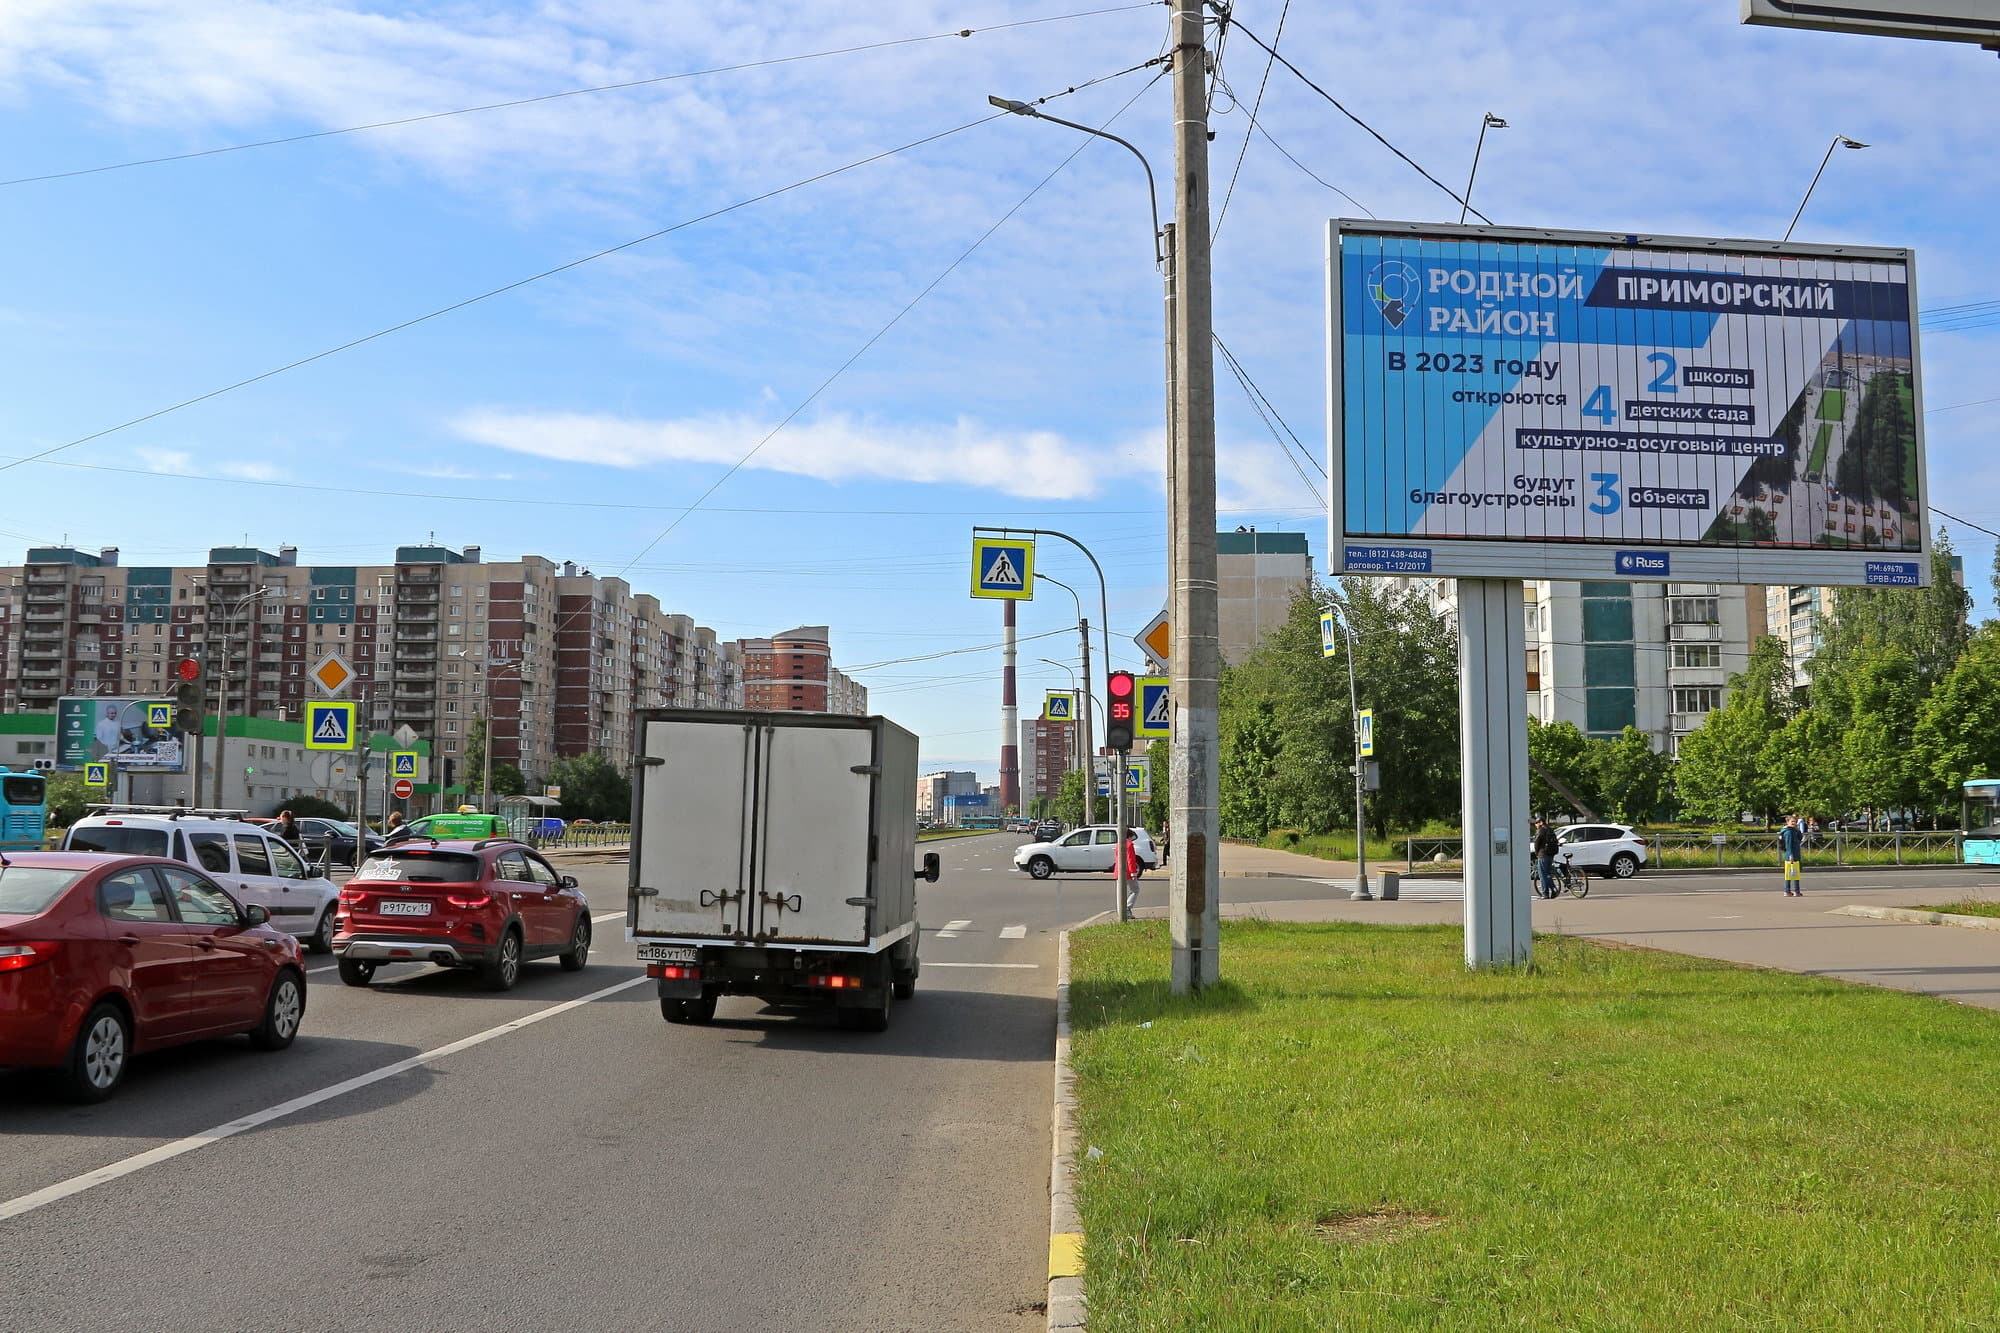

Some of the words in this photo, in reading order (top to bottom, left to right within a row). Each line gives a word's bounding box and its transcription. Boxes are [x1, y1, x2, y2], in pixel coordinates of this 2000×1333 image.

[1428, 268, 1584, 302] РОДНОЙ
[1617, 276, 1835, 311] ПРИМОРСКИЙ
[1429, 303, 1556, 337] РАЙОН
[1388, 351, 1407, 371] В
[1415, 352, 1484, 374] 2023
[1494, 359, 1560, 381] году
[1646, 351, 1679, 394] 2
[1688, 370, 1749, 385] школы
[1452, 390, 1567, 407] откроются
[1581, 385, 1617, 426] 4
[1629, 404, 1702, 420] детских
[1707, 408, 1749, 422] сада
[1521, 434, 1726, 453] культурно-досуговый
[1731, 441, 1785, 457] центр
[1513, 474, 1575, 493] будут
[1588, 472, 1621, 515] 3
[1631, 489, 1706, 505] объекта
[1409, 489, 1576, 509] благоустроены
[1368, 549, 1389, 559] (812)
[1390, 550, 1428, 559] 438-4848
[1635, 556, 1665, 568] Russ
[1348, 562, 1384, 571] договор:
[1113, 703, 1130, 718] 35
